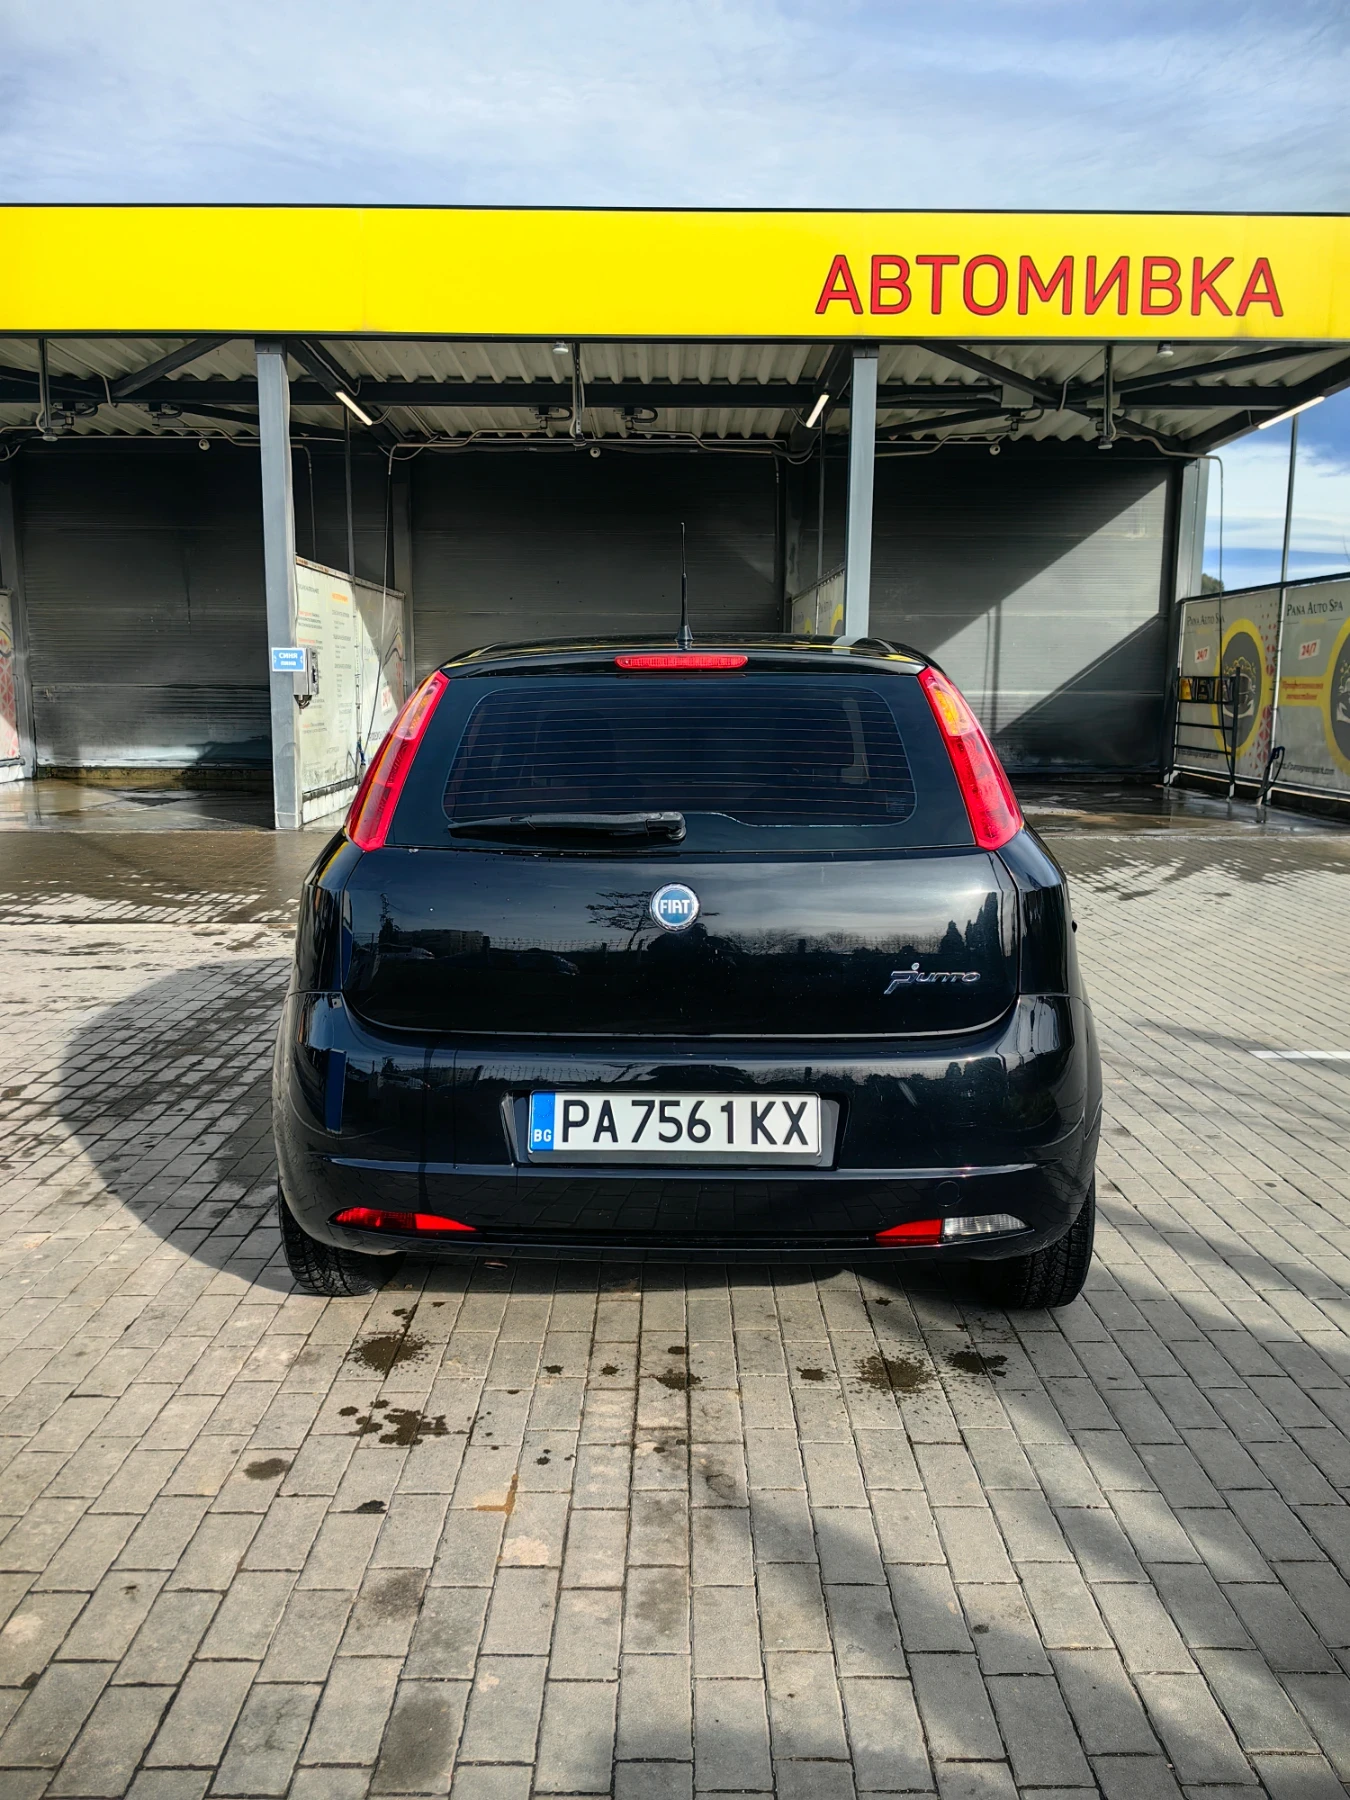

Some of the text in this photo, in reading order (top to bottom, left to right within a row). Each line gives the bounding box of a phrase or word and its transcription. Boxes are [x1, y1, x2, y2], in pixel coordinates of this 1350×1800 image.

[815, 253, 1284, 318] АВТОМИВКА
[1301, 642, 1317, 656] 24/7
[659, 899, 691, 914] FIAT
[533, 1129, 552, 1143] BG
